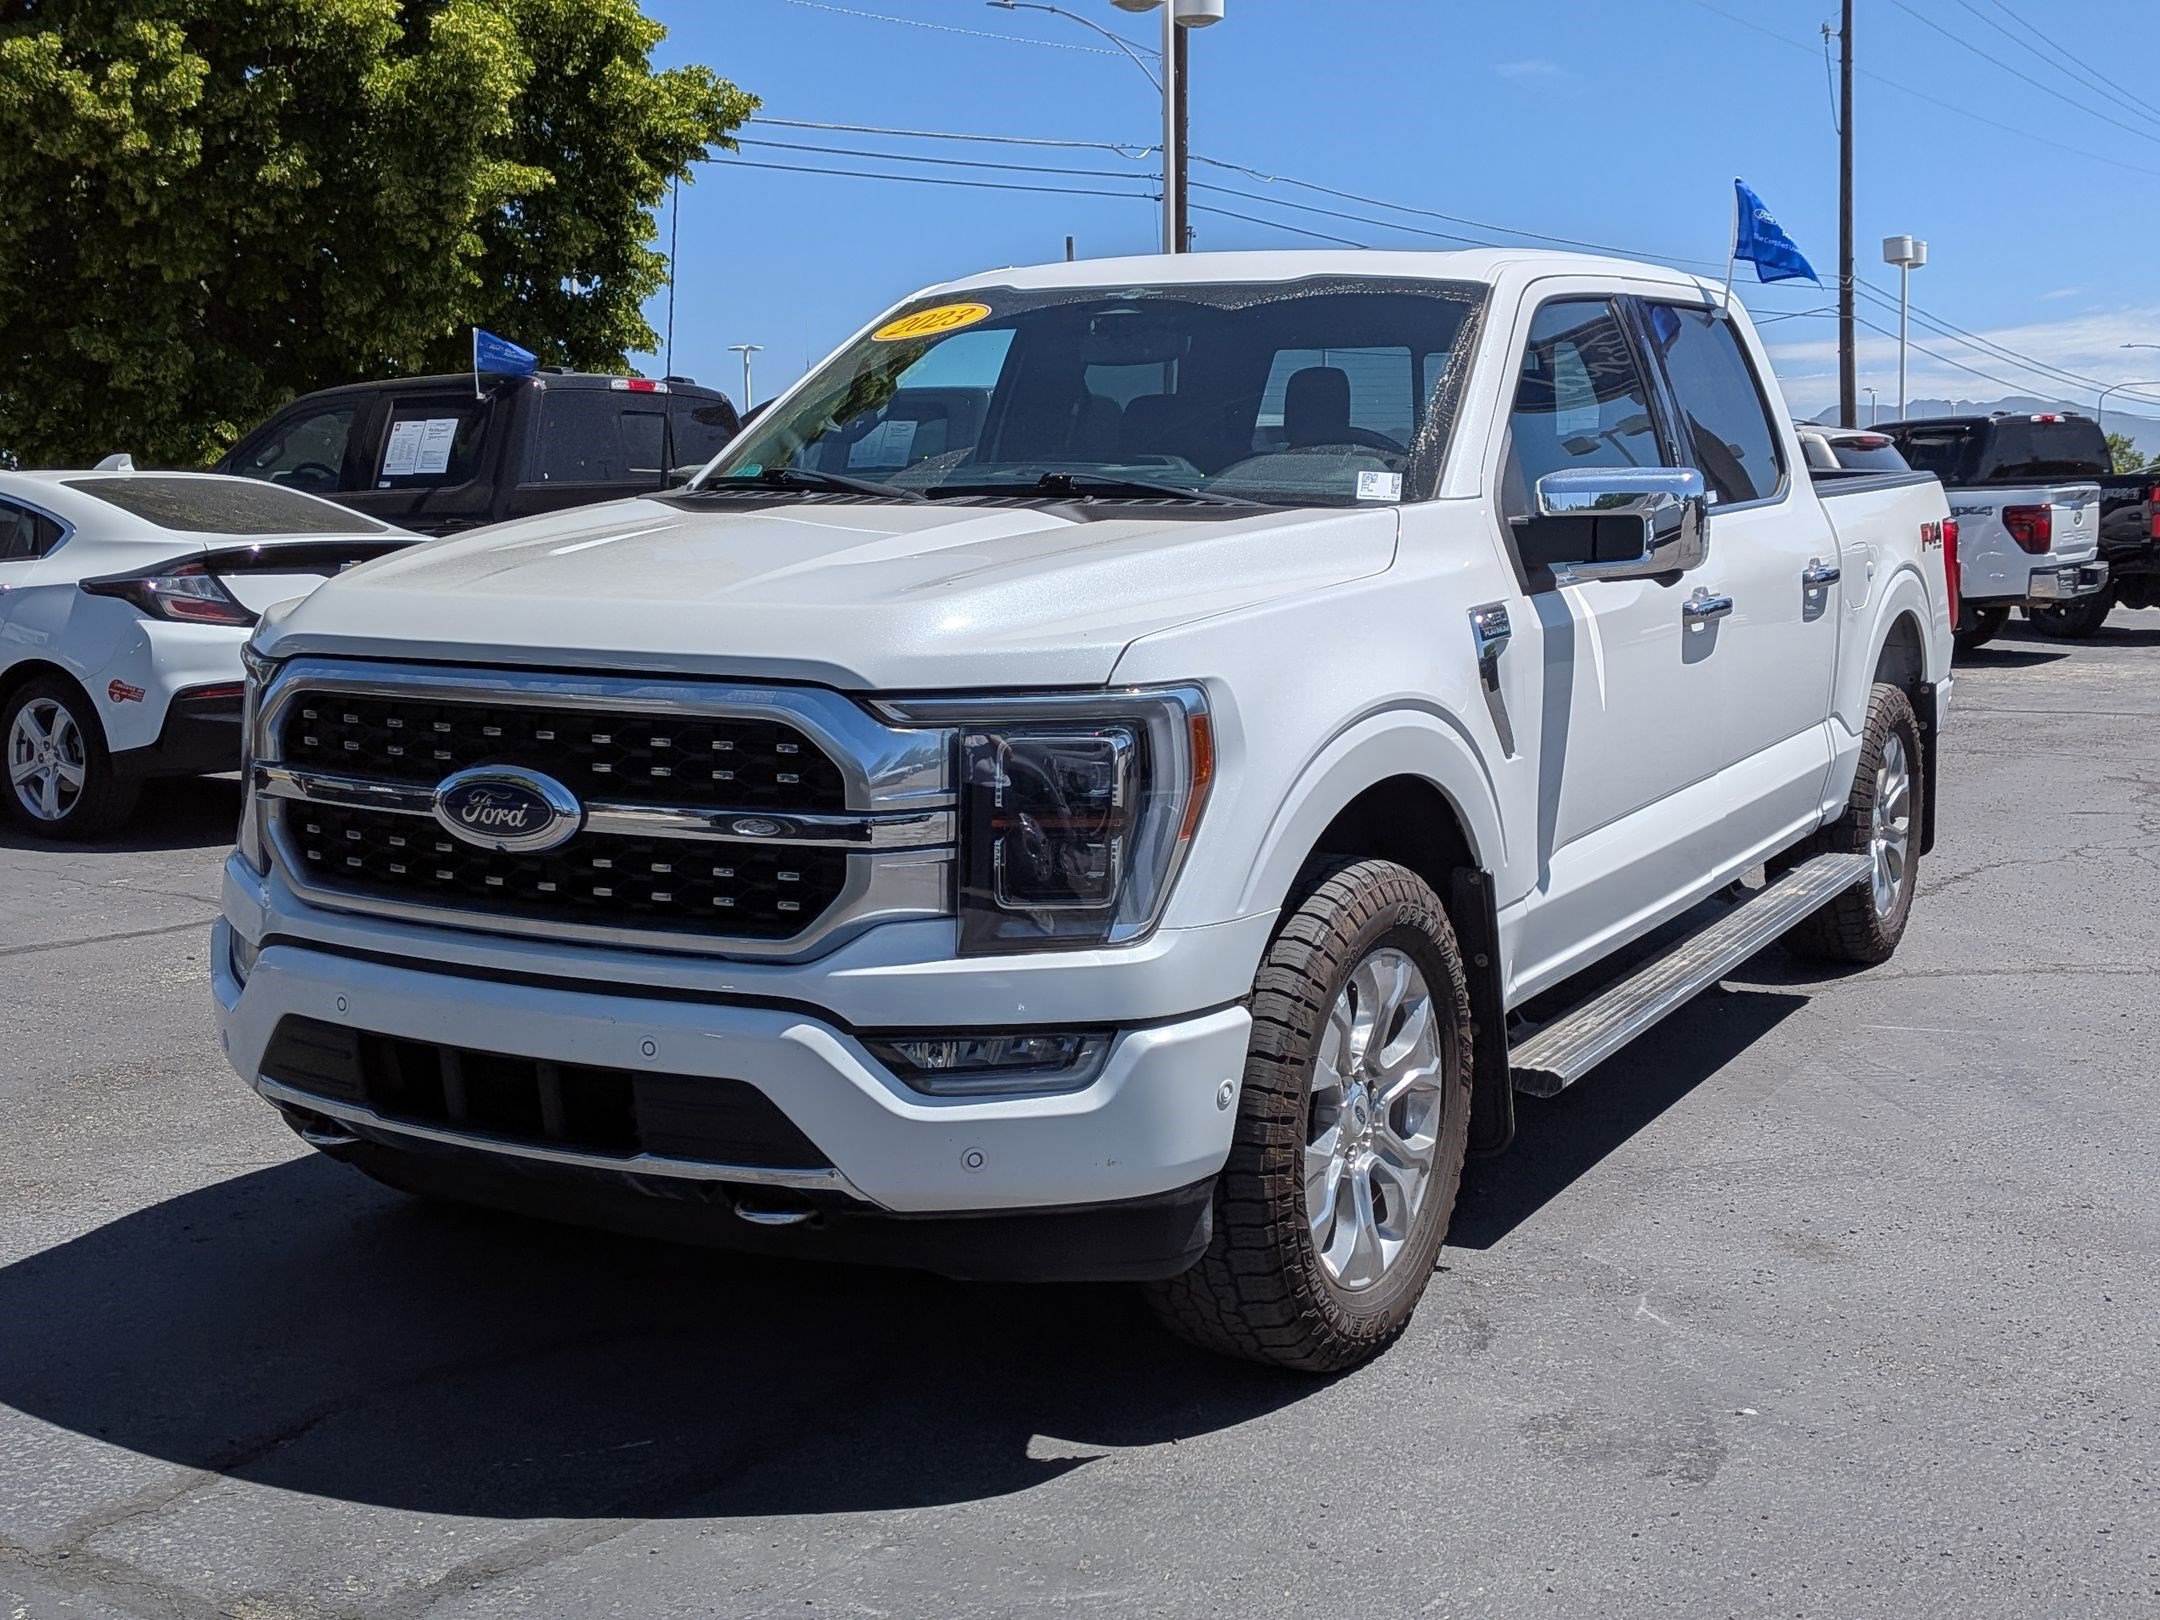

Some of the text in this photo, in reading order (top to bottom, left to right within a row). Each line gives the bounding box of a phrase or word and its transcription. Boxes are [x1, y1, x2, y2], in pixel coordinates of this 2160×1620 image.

[885, 307, 977, 337] 2023
[461, 788, 529, 828] Ford
[1395, 903, 1440, 938] OPEN
[1297, 1227, 1340, 1324] RANGE
[1339, 1310, 1391, 1338] OPEN
